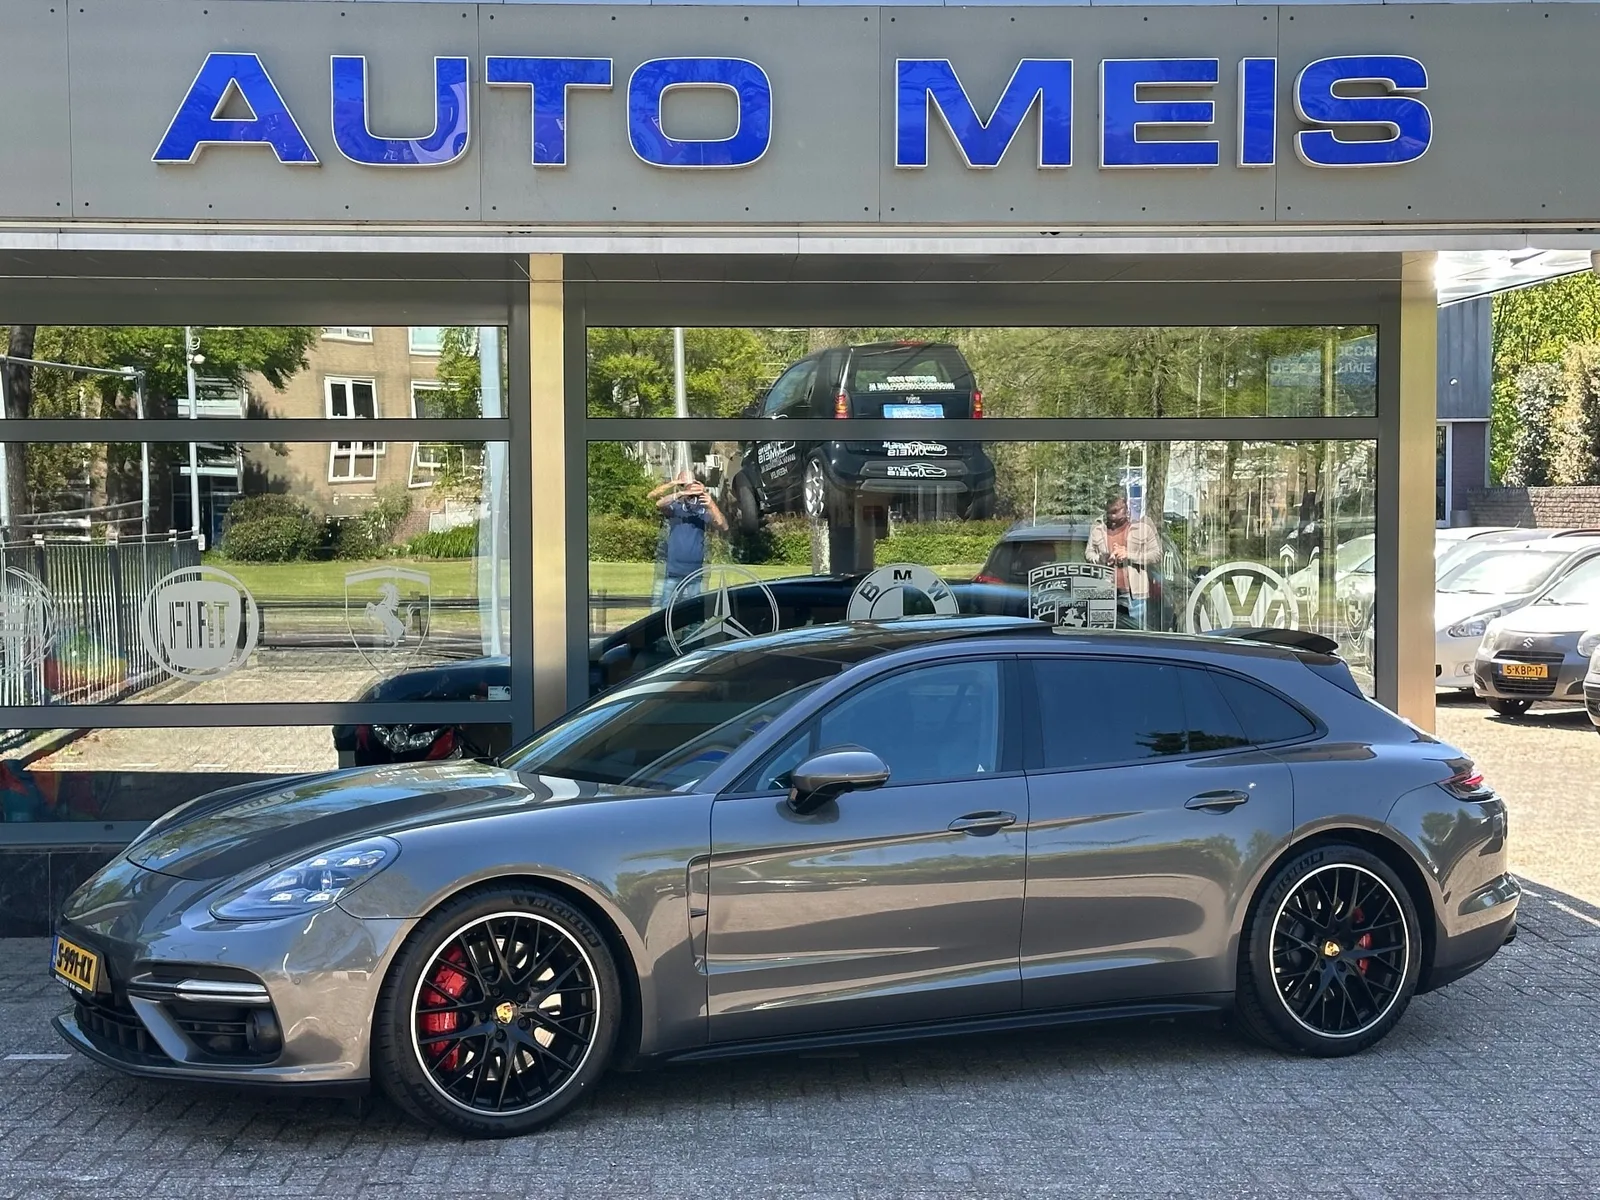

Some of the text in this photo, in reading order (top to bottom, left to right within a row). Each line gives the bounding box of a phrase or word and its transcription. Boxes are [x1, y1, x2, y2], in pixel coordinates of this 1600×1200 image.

[152, 52, 1434, 170] AUTO MEIS
[1031, 565, 1115, 583] PORSCHE
[169, 601, 229, 649] FIAT
[1506, 665, 1543, 676] 5-KBP-17
[1272, 851, 1324, 900] MICHELIN
[532, 897, 601, 944] MICHELIN
